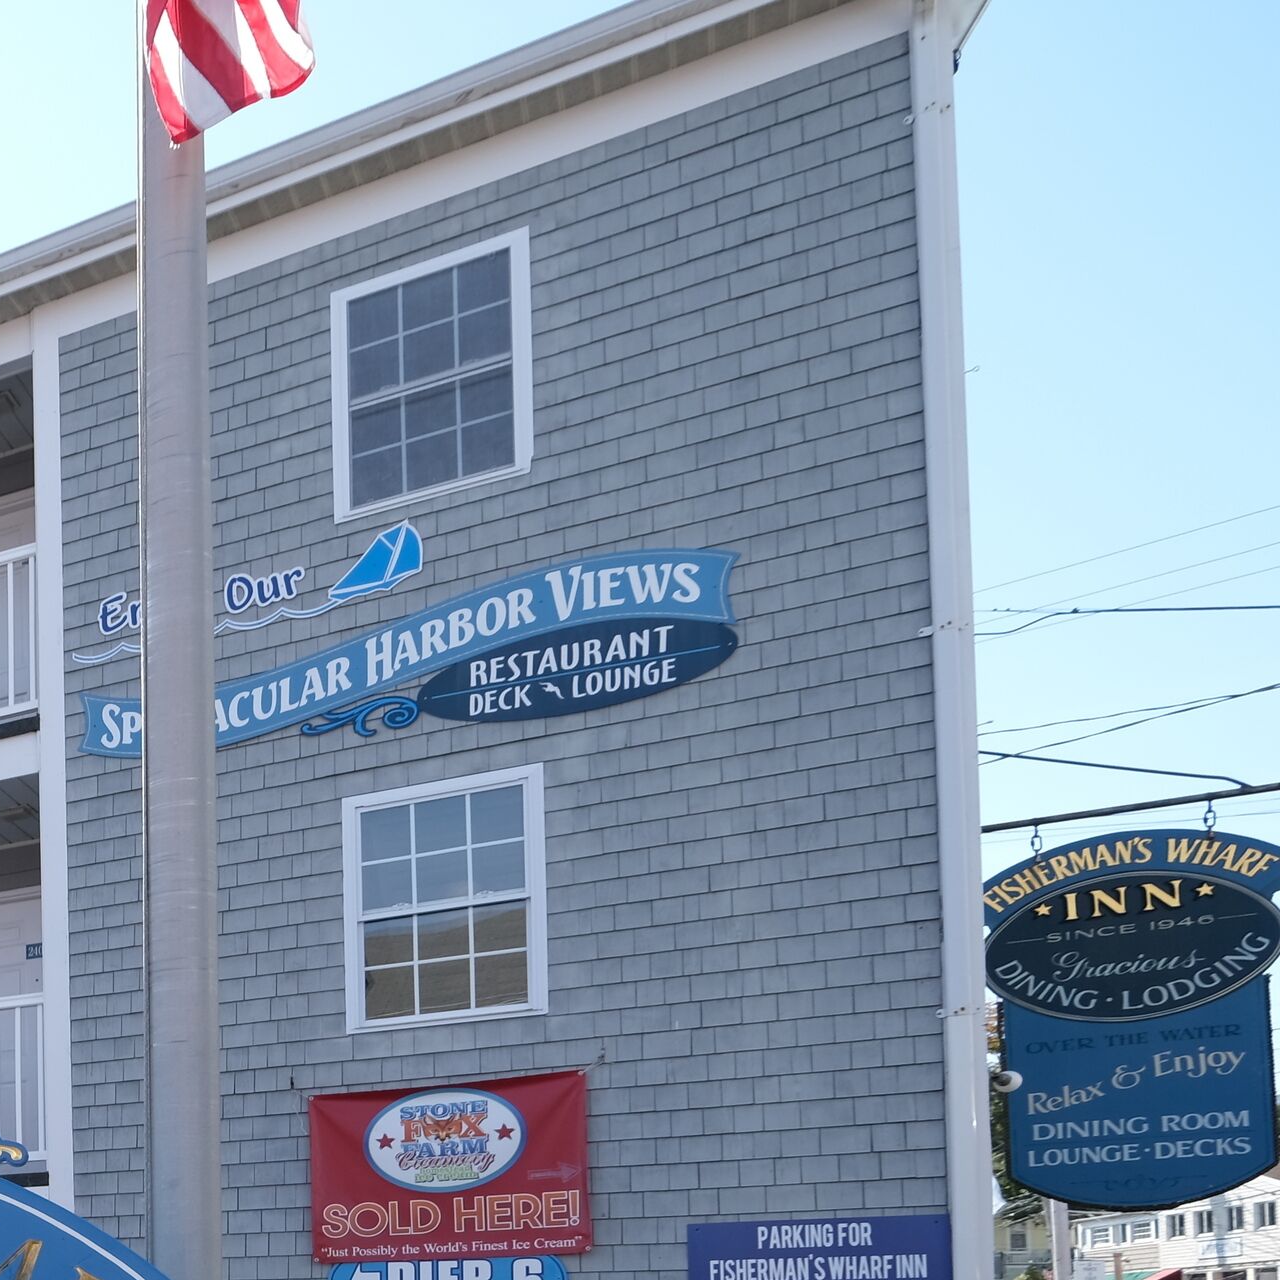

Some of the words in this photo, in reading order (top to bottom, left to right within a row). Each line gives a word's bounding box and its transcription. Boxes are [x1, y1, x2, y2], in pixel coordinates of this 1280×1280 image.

[225, 567, 302, 613] Our
[101, 656, 350, 749] SPACULAR
[365, 588, 533, 683] HARBOR
[546, 563, 700, 621] VIEWS
[470, 625, 674, 687] RESTAURANT
[469, 681, 533, 717] DECK
[571, 659, 677, 699] LOUNGE
[983, 836, 1152, 913] FISHERMAN'S
[1167, 837, 1279, 878] WHARF
[1063, 879, 1183, 921] INN
[1046, 923, 1137, 943] SINCE
[1150, 914, 1214, 931] 1946
[995, 959, 1099, 1010] DINING
[1122, 932, 1271, 1011] LODGING
[1052, 949, 1206, 982] Gracious
[1026, 1037, 1096, 1054] OVER
[1104, 1032, 1149, 1048] THE
[1159, 1023, 1241, 1042] WATER
[1028, 1081, 1106, 1115] Relax
[1111, 1064, 1146, 1090] &
[1152, 1046, 1245, 1078] Enjoy
[400, 1099, 489, 1120] STONE
[1032, 1116, 1149, 1141] DINING
[1161, 1109, 1250, 1133] ROOM
[395, 1151, 495, 1174] Creamery
[402, 1137, 489, 1158] FARM
[1028, 1144, 1140, 1167] LOUNGE
[1154, 1136, 1252, 1160] DECKS
[322, 1200, 441, 1238] SOLD
[453, 1189, 580, 1233] HERE!
[352, 1244, 398, 1258] Possibly
[402, 1243, 420, 1255] the
[424, 1240, 468, 1253] World's
[471, 1239, 508, 1252] Finest
[512, 1239, 530, 1250] Ice
[757, 1223, 833, 1249] PARKING
[838, 1222, 872, 1247] FOR
[828, 1254, 893, 1280] WHARF
[895, 1254, 928, 1279] INN
